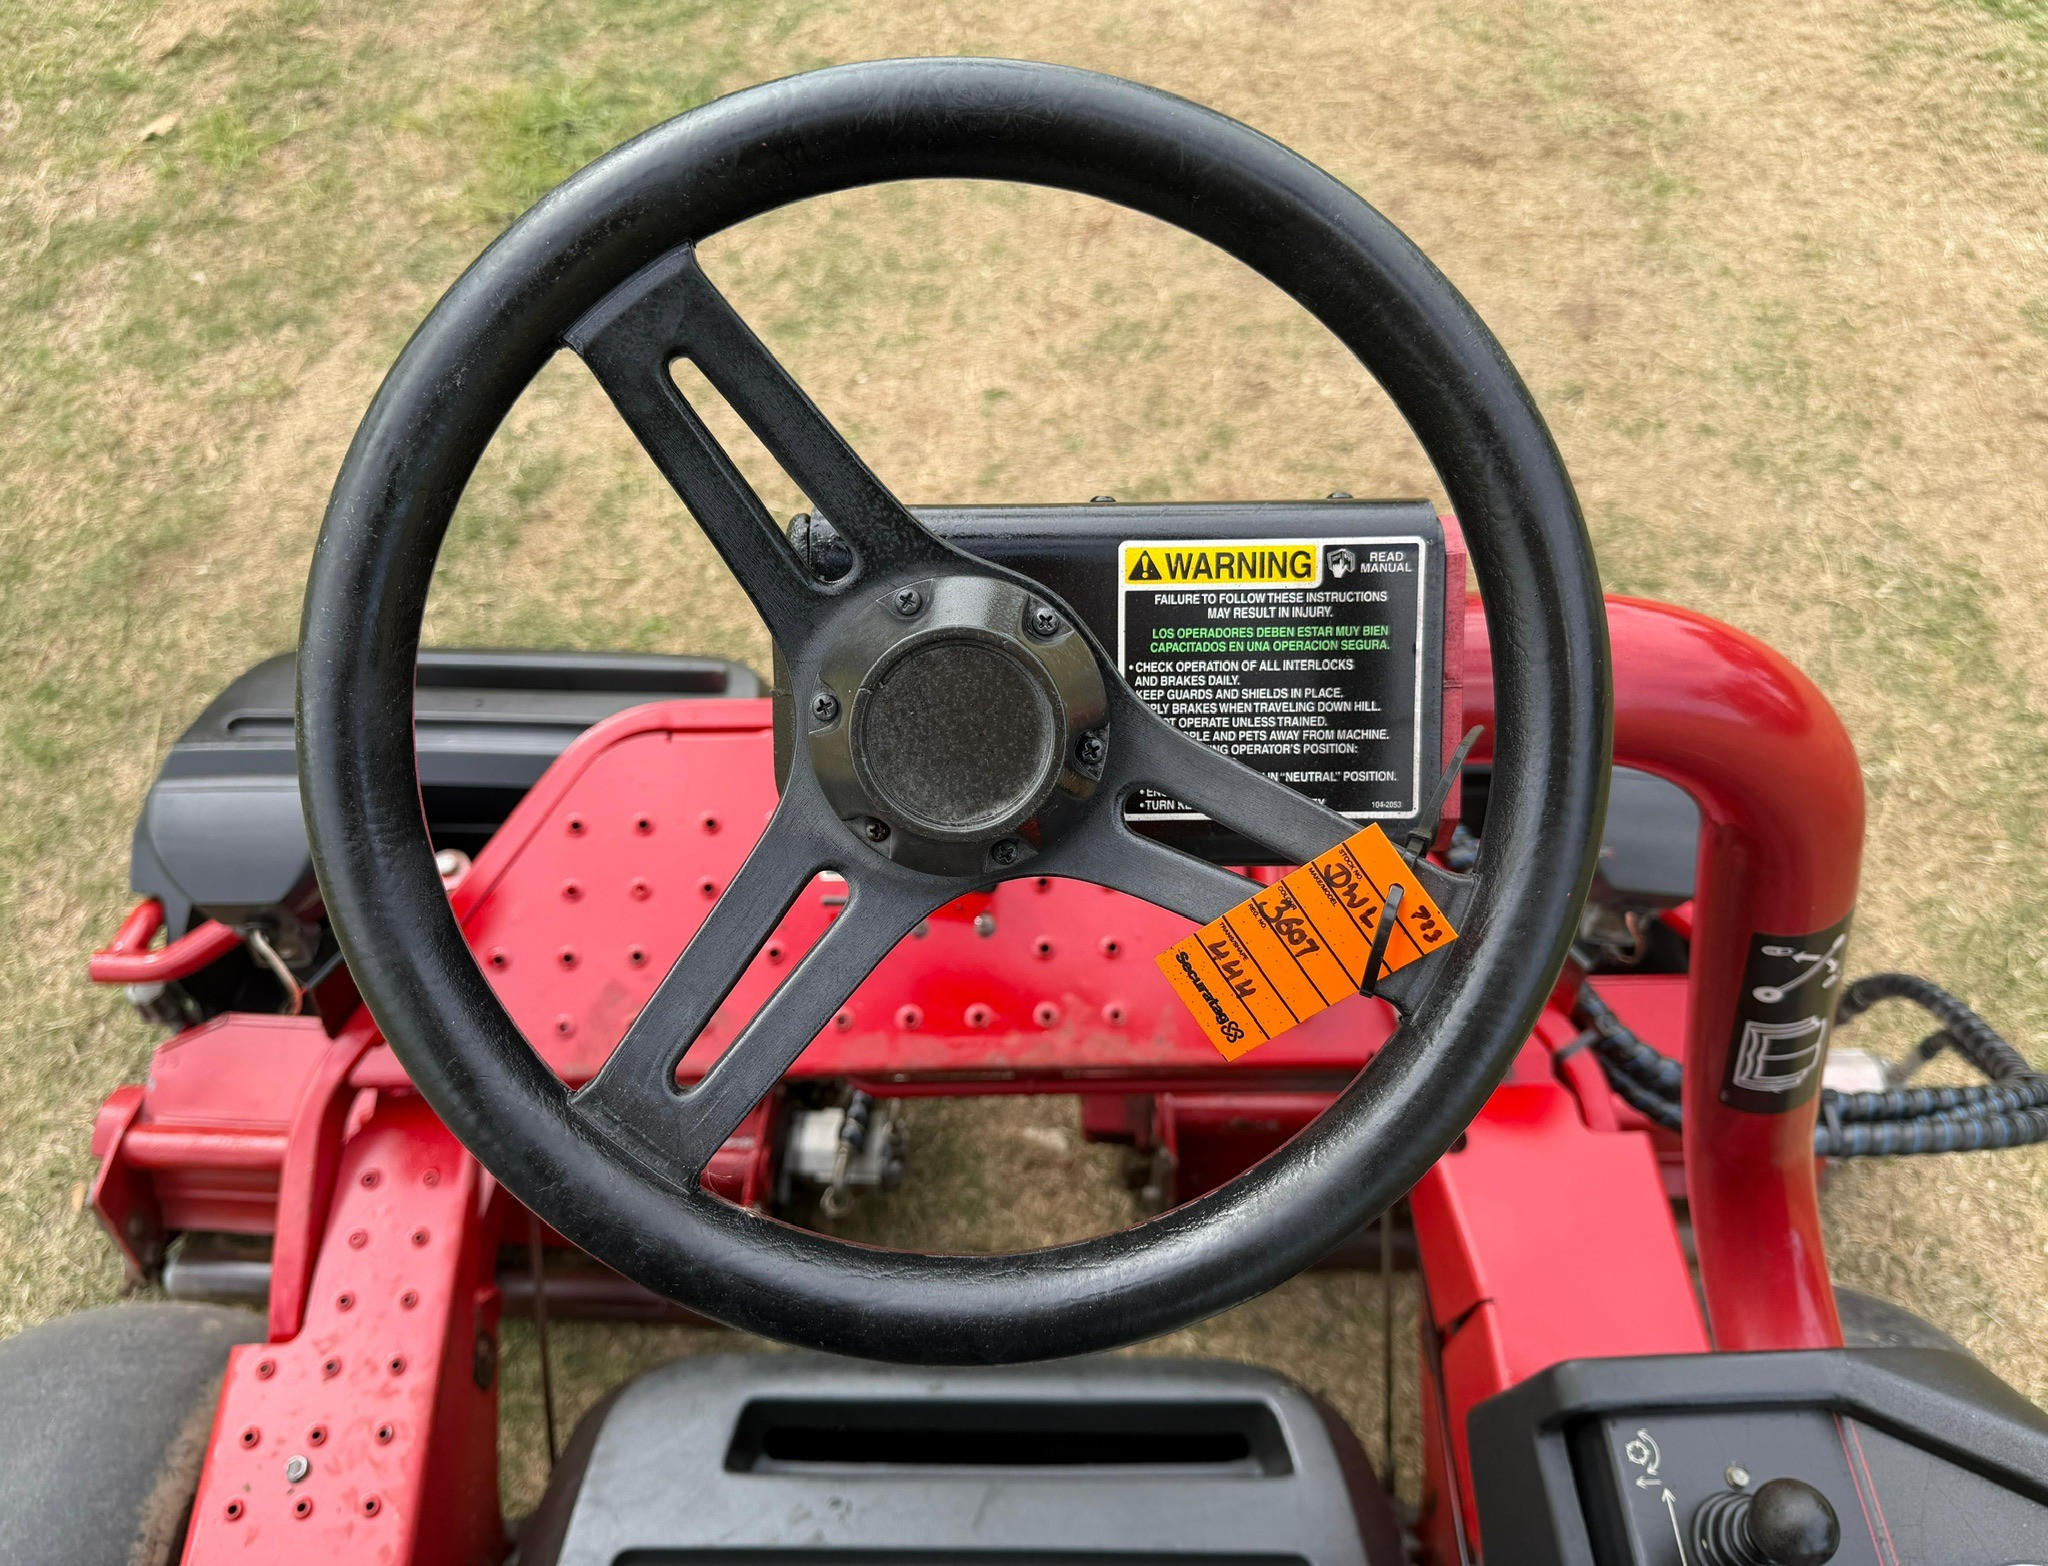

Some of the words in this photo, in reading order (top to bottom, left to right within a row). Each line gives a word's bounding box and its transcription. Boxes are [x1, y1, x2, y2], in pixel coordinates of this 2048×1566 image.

[1370, 551, 1404, 562] READ
[1165, 551, 1311, 580] WARNING
[1360, 563, 1412, 573] MANUAL
[1155, 594, 1200, 605] FAILURE
[1202, 593, 1216, 604] TO
[1219, 592, 1267, 604] FOLLOW
[1267, 592, 1303, 603] THESE
[1306, 591, 1387, 602] INSTRUCTIONS
[1207, 608, 1230, 619] MAY
[1234, 607, 1275, 618] RESULT
[1278, 607, 1289, 617] IN
[1292, 606, 1333, 618] INJURY.
[1153, 627, 1174, 639] LOS
[1177, 627, 1253, 638] OPERADORES
[1257, 626, 1294, 638] DEBEN
[1297, 626, 1333, 637] ESTAR
[1336, 625, 1359, 636] MUY
[1362, 625, 1389, 636] BIEN
[1150, 641, 1226, 653] CAPACITADOS
[1229, 641, 1243, 652] EN
[1246, 640, 1270, 652] UNA
[1273, 640, 1338, 651] OPERACION
[1340, 639, 1390, 651] SEGURA.
[1135, 661, 1173, 673] CHECK
[1176, 660, 1238, 672] OPERATION
[1242, 660, 1257, 671] OF
[1259, 660, 1280, 671] ALL
[1283, 659, 1354, 671] INTERLOCKS
[1135, 675, 1158, 687] AND
[1160, 675, 1205, 686] BRAKES
[1208, 674, 1240, 686] DAILY.
[1135, 689, 1165, 700] KEEP
[1166, 689, 1213, 700] GUARDS
[1215, 688, 1238, 699] AND
[1242, 688, 1288, 699] SHIELDS
[1290, 688, 1301, 698] IN
[1304, 687, 1343, 698] PLACE.
[1172, 703, 1217, 714] BRAKES
[1218, 702, 1252, 713] WHEN
[1253, 701, 1315, 713] TRAVELING
[1317, 701, 1351, 712] DOWN
[1354, 700, 1380, 712] HILL.
[1178, 717, 1229, 728] OPERATE
[1232, 716, 1276, 728] UNLESS
[1277, 716, 1327, 727] TRAINED.
[1212, 730, 1236, 741] AND
[1238, 730, 1267, 741] PETS
[1268, 730, 1300, 741] AWAY
[1302, 729, 1334, 740] FROM
[1336, 728, 1389, 740] MACHINE.
[1303, 743, 1358, 754] POSITION:
[1343, 770, 1396, 781] POSITION.
[1145, 800, 1175, 810] TURN
[1371, 801, 1401, 809] 104-2053
[1338, 848, 1357, 870] STOCK
[1353, 869, 1363, 880] NO.
[1308, 867, 1337, 906] MAKE/MODEL
[1256, 898, 1320, 957] 3607
[1257, 917, 1266, 929] NO.
[1219, 921, 1248, 961] TRANS/SHAPE
[1175, 951, 1229, 1025] Securatag
